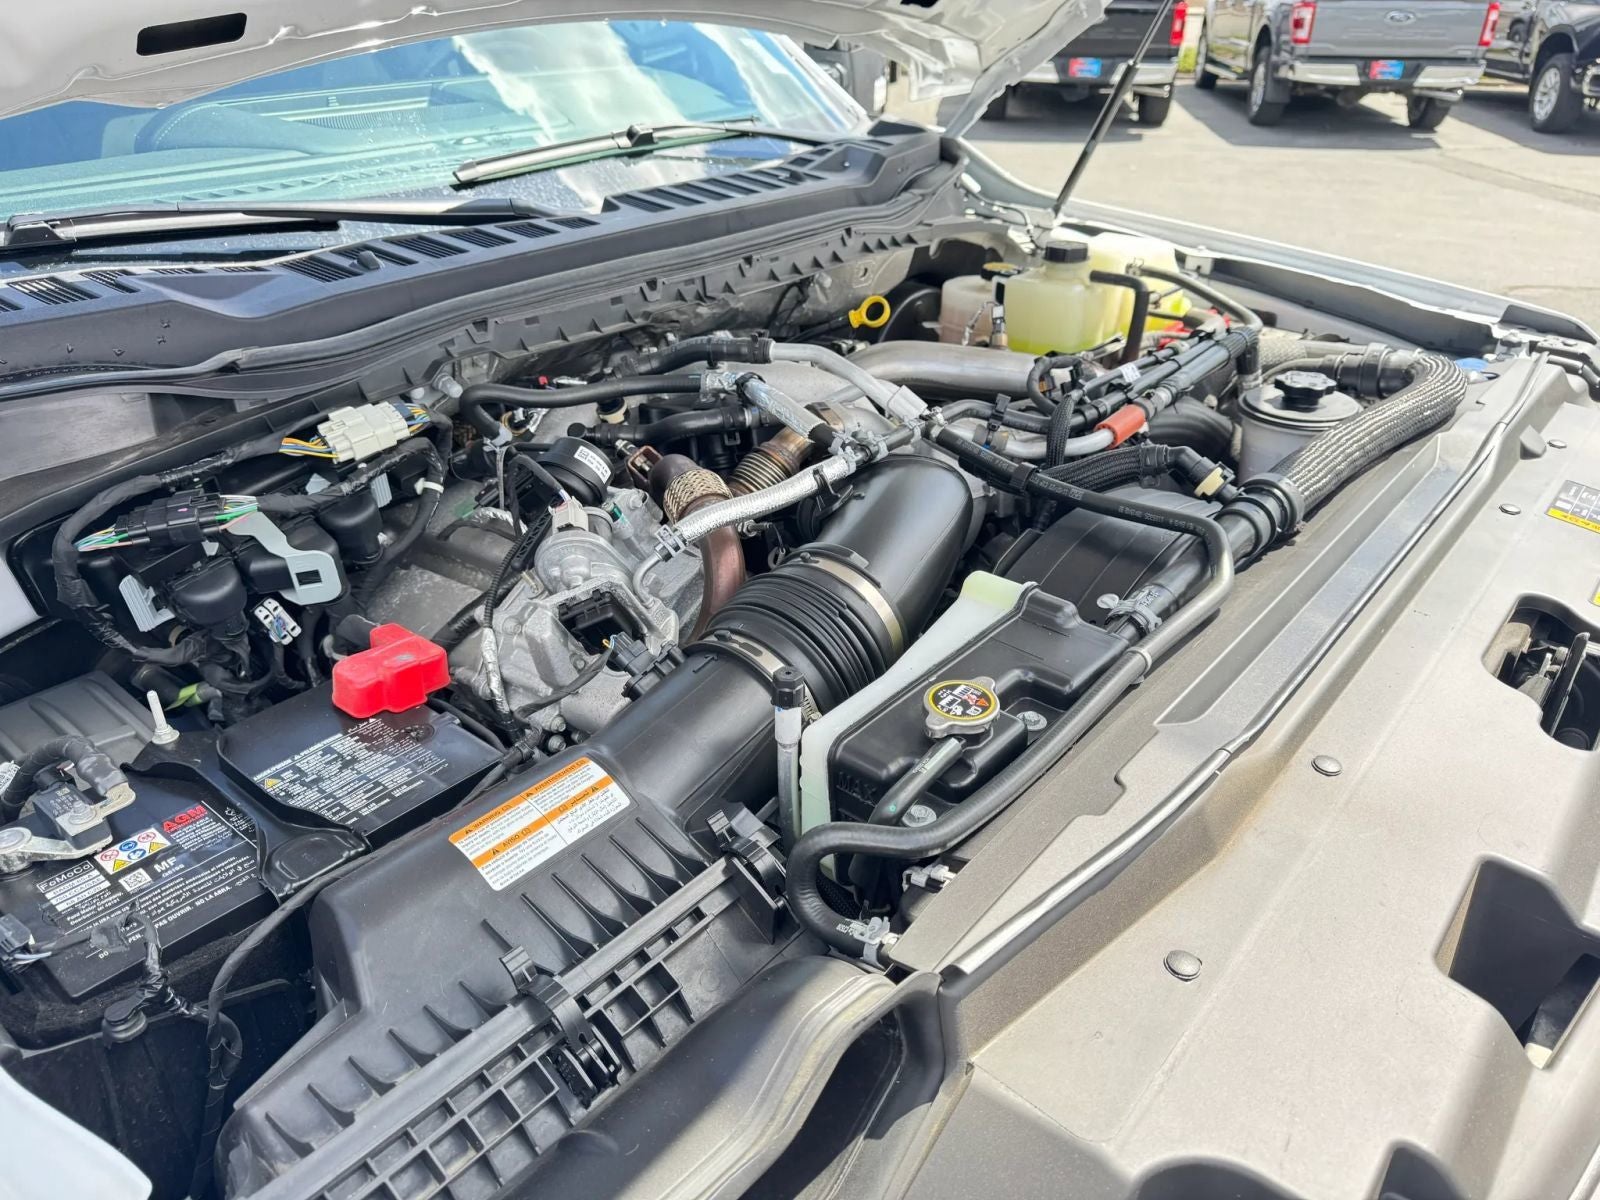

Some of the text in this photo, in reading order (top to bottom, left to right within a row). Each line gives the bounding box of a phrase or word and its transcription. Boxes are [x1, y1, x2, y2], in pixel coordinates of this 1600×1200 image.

[163, 805, 206, 833] AGM
[473, 811, 501, 828] WARNING
[502, 834, 521, 847] AVISO
[154, 857, 177, 872] MF
[40, 863, 91, 891] FoMoCo
